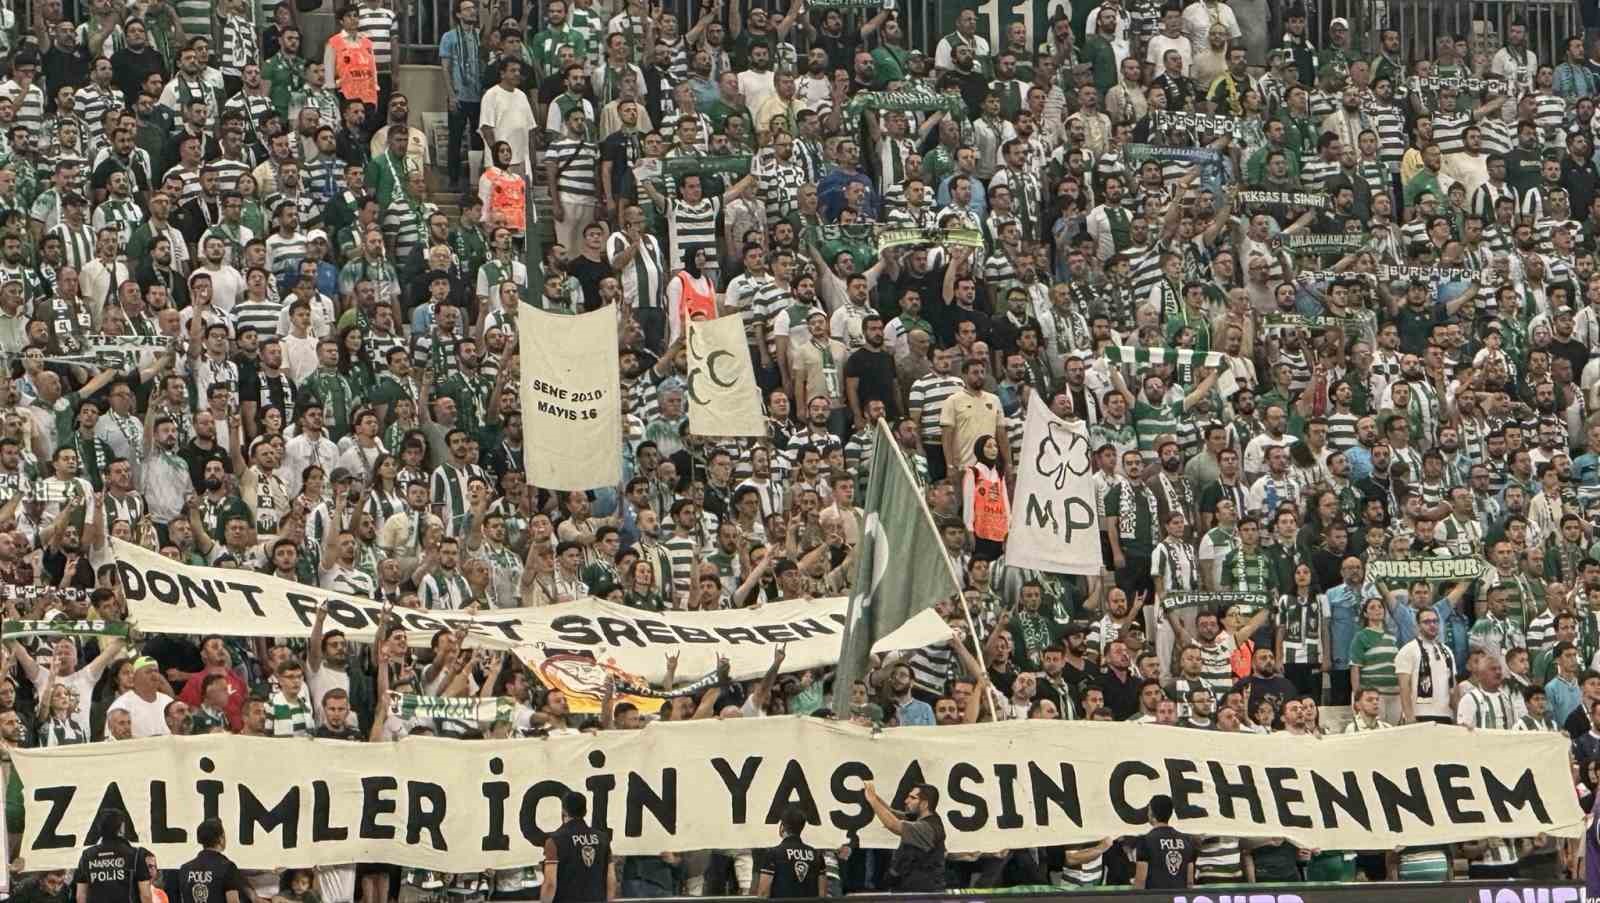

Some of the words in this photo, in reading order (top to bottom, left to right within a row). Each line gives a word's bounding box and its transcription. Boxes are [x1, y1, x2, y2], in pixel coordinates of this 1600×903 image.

[978, 0, 1073, 57] 11
[533, 379, 568, 400] SENE
[571, 390, 602, 402] 2010
[537, 400, 577, 421] MAYIS
[581, 408, 597, 419] 16
[1376, 559, 1480, 578] BURSASPOR
[116, 560, 266, 617] DON'T
[286, 593, 524, 642] FORGET
[550, 613, 847, 648] SREBREN
[1163, 593, 1267, 609] BURSASPOR
[31, 756, 448, 852] ZALİMLER
[1109, 757, 1554, 834] CEHENNEM
